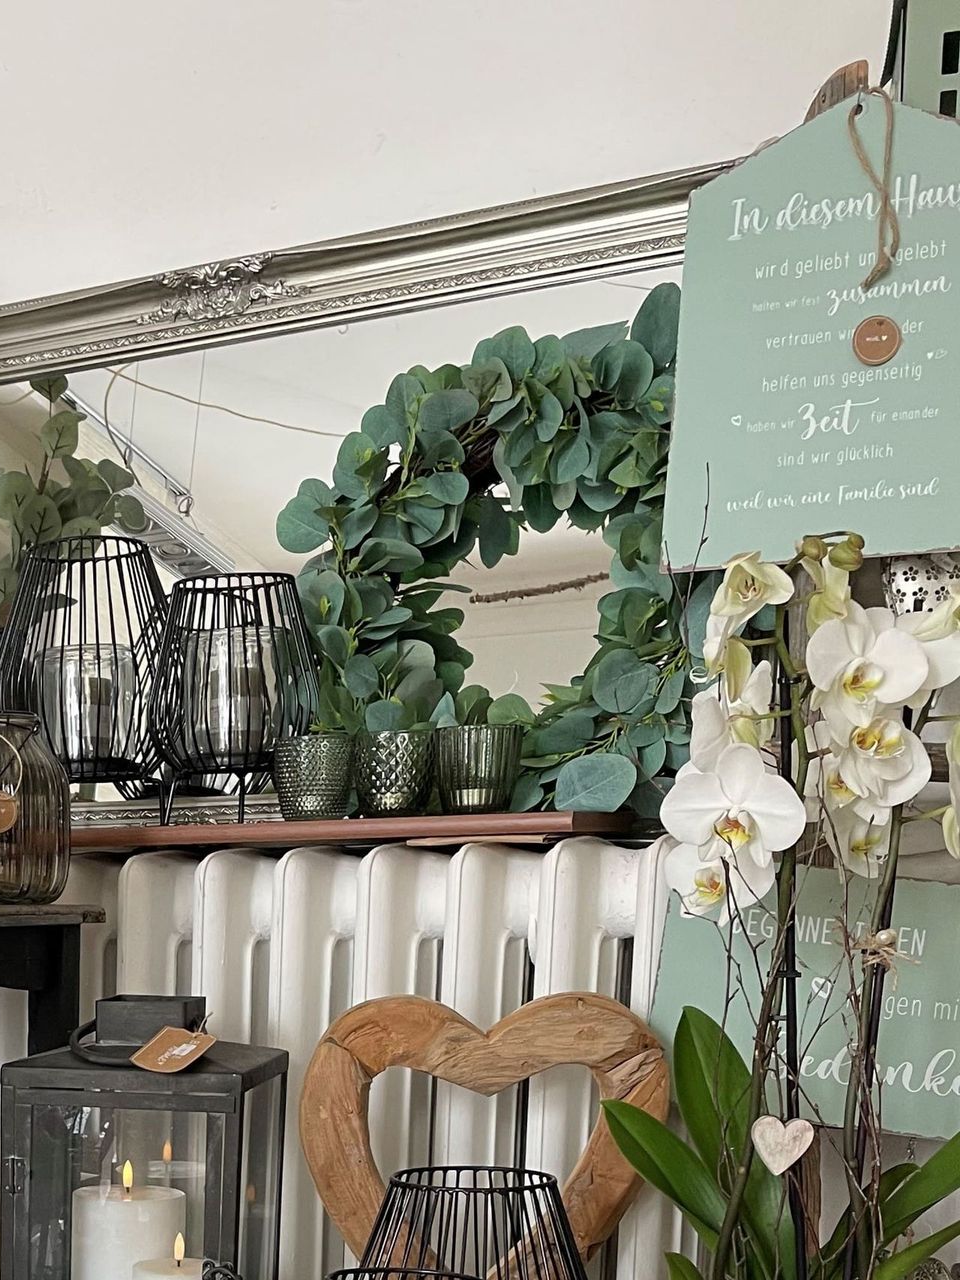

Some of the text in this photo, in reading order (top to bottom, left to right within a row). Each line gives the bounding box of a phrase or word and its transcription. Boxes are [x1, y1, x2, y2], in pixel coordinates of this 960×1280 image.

[727, 173, 960, 241] In diesem Hau
[755, 239, 948, 280] wird geliebt un gelebt
[826, 274, 953, 317] zusammen
[765, 330, 833, 350] vertrauen
[762, 362, 923, 393] helfen uns gegenseitig
[746, 396, 940, 441] haben wir Zeit für einander
[776, 443, 895, 468] sind wir glücklich
[726, 476, 941, 513] weil wir eine Familie sind
[732, 908, 836, 946] BEGNNE
[933, 998, 960, 1021] mi
